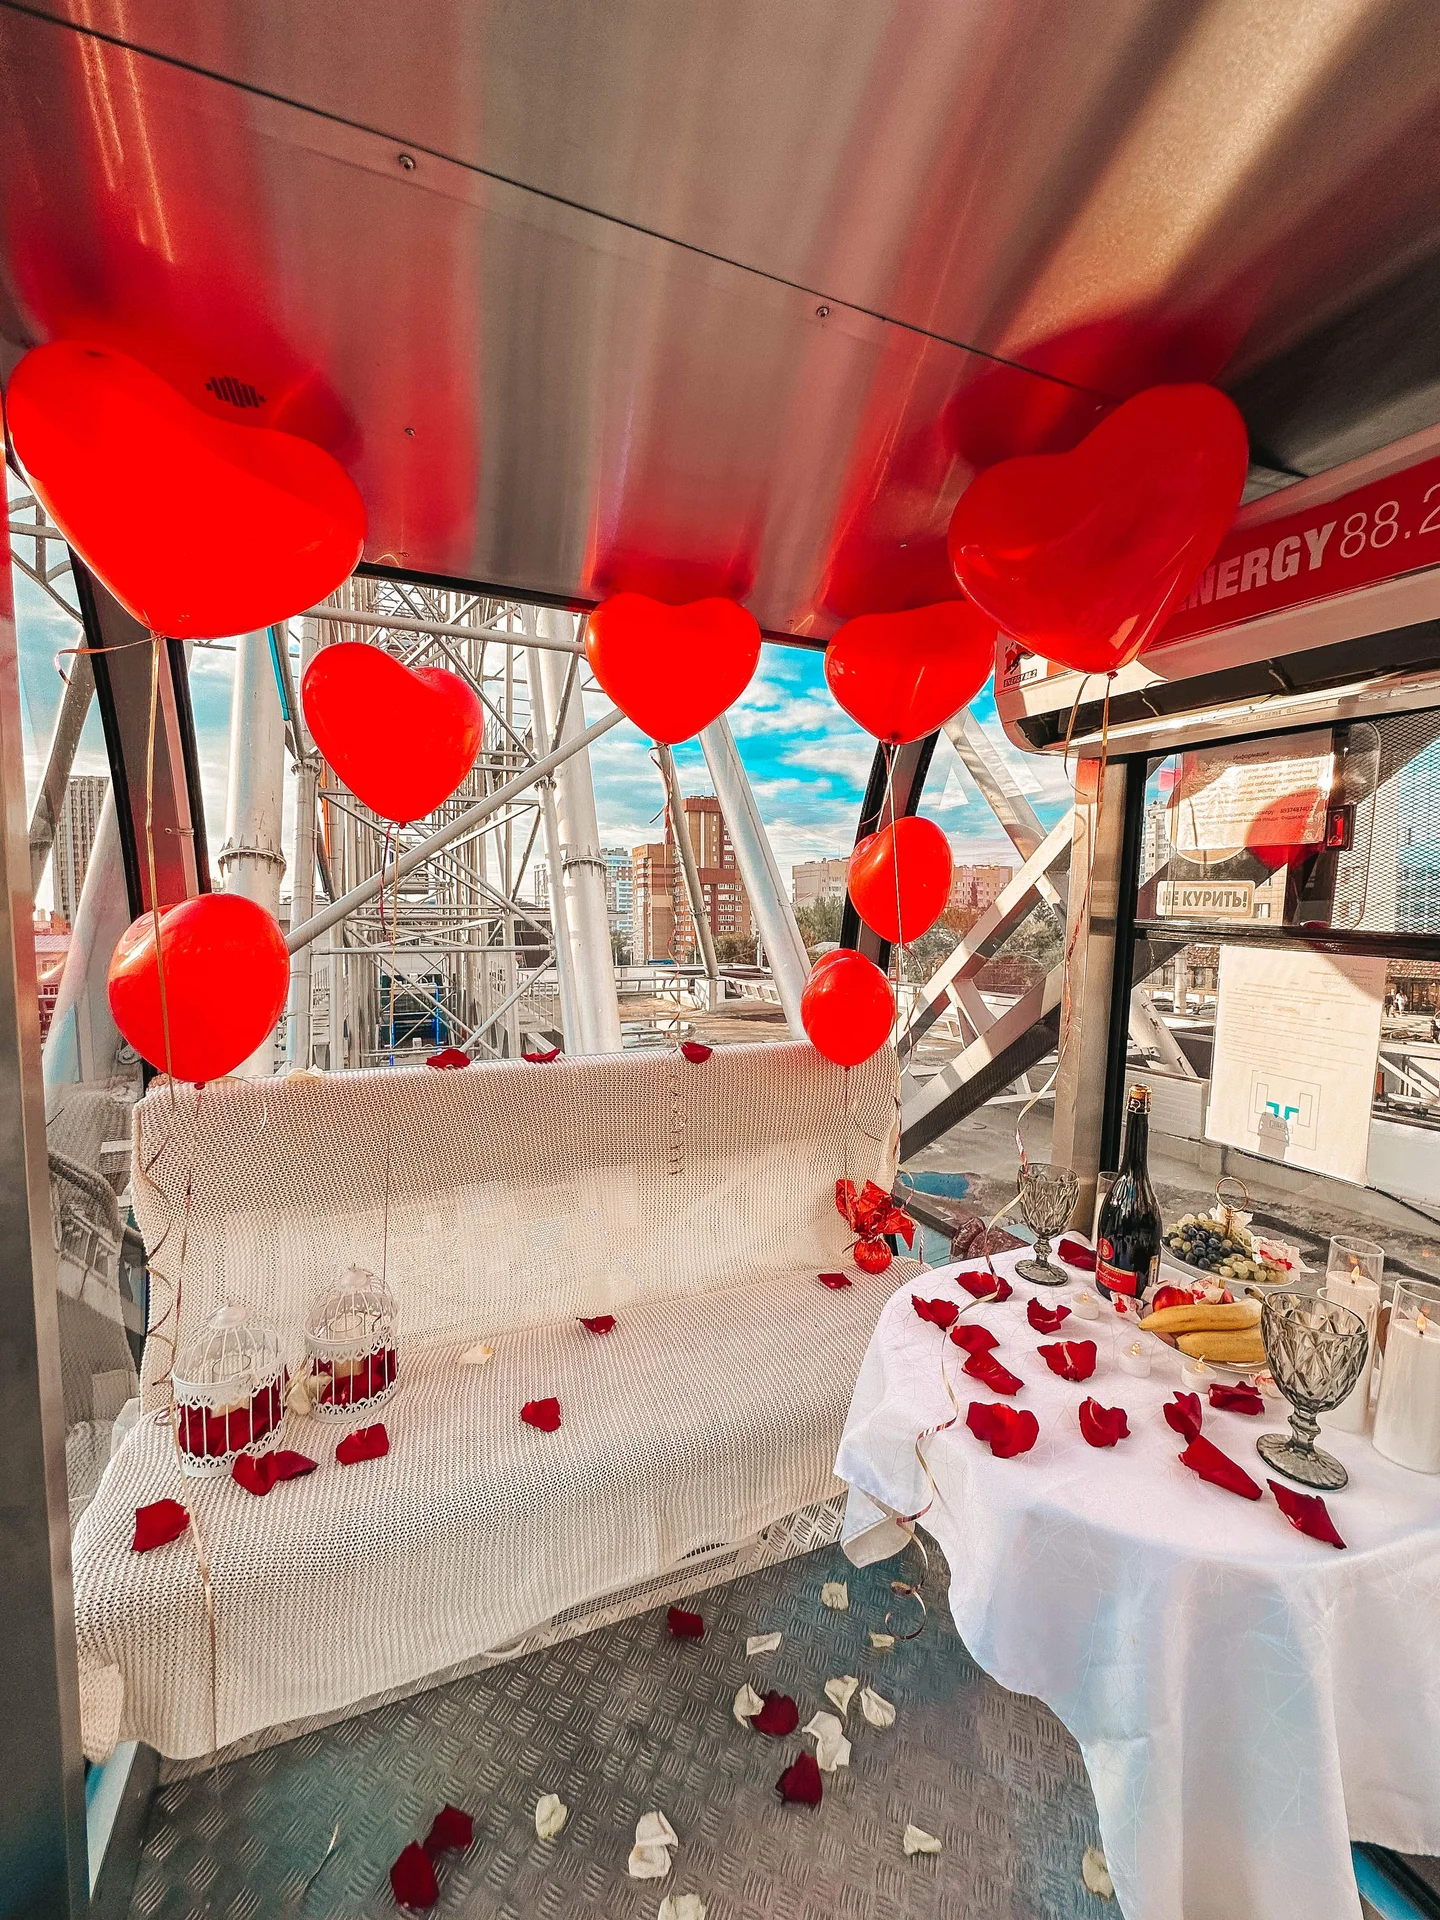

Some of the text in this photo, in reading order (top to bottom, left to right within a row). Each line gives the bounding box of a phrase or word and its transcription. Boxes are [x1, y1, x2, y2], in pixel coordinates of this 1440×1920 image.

[1173, 521, 1337, 614] NERGY
[1162, 890, 1248, 908] НЕ КУРИТЬ!
